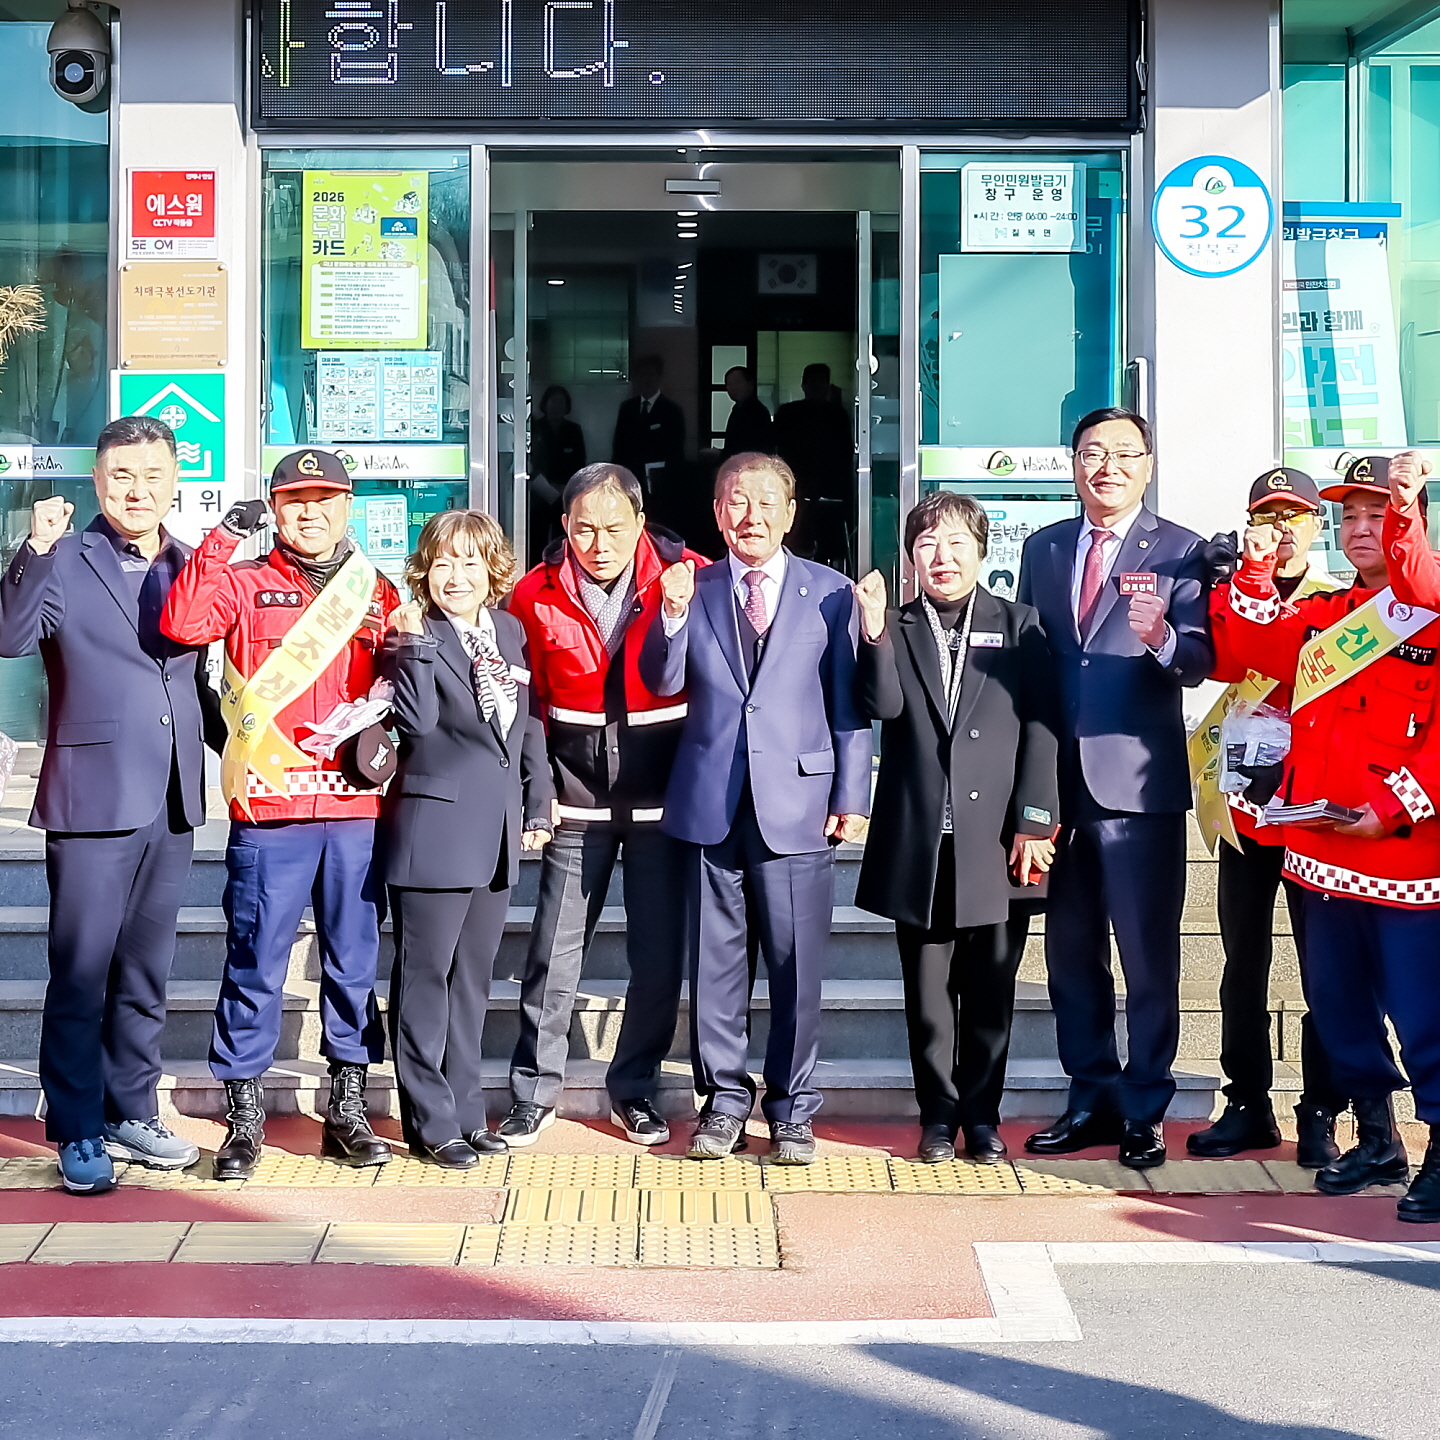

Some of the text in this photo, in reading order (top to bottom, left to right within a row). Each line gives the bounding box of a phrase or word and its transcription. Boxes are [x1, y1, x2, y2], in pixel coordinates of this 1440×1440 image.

[981, 174, 1067, 188] 무인민원발급기
[146, 193, 203, 216] 에스원
[313, 191, 345, 202] 2026
[312, 205, 347, 222] 문화
[1025, 211, 1048, 221] 06:00
[1179, 204, 1247, 239] 32
[312, 222, 346, 239] 누리
[131, 238, 174, 250] SECOM
[312, 239, 346, 256] 카드
[1186, 242, 1241, 257] 칠북로
[133, 285, 217, 298] 치매극복선도기관
[1324, 309, 1364, 332] 함께
[363, 455, 410, 471] HamAn
[1022, 456, 1068, 472] HamAn
[988, 521, 1043, 544] 을변호
